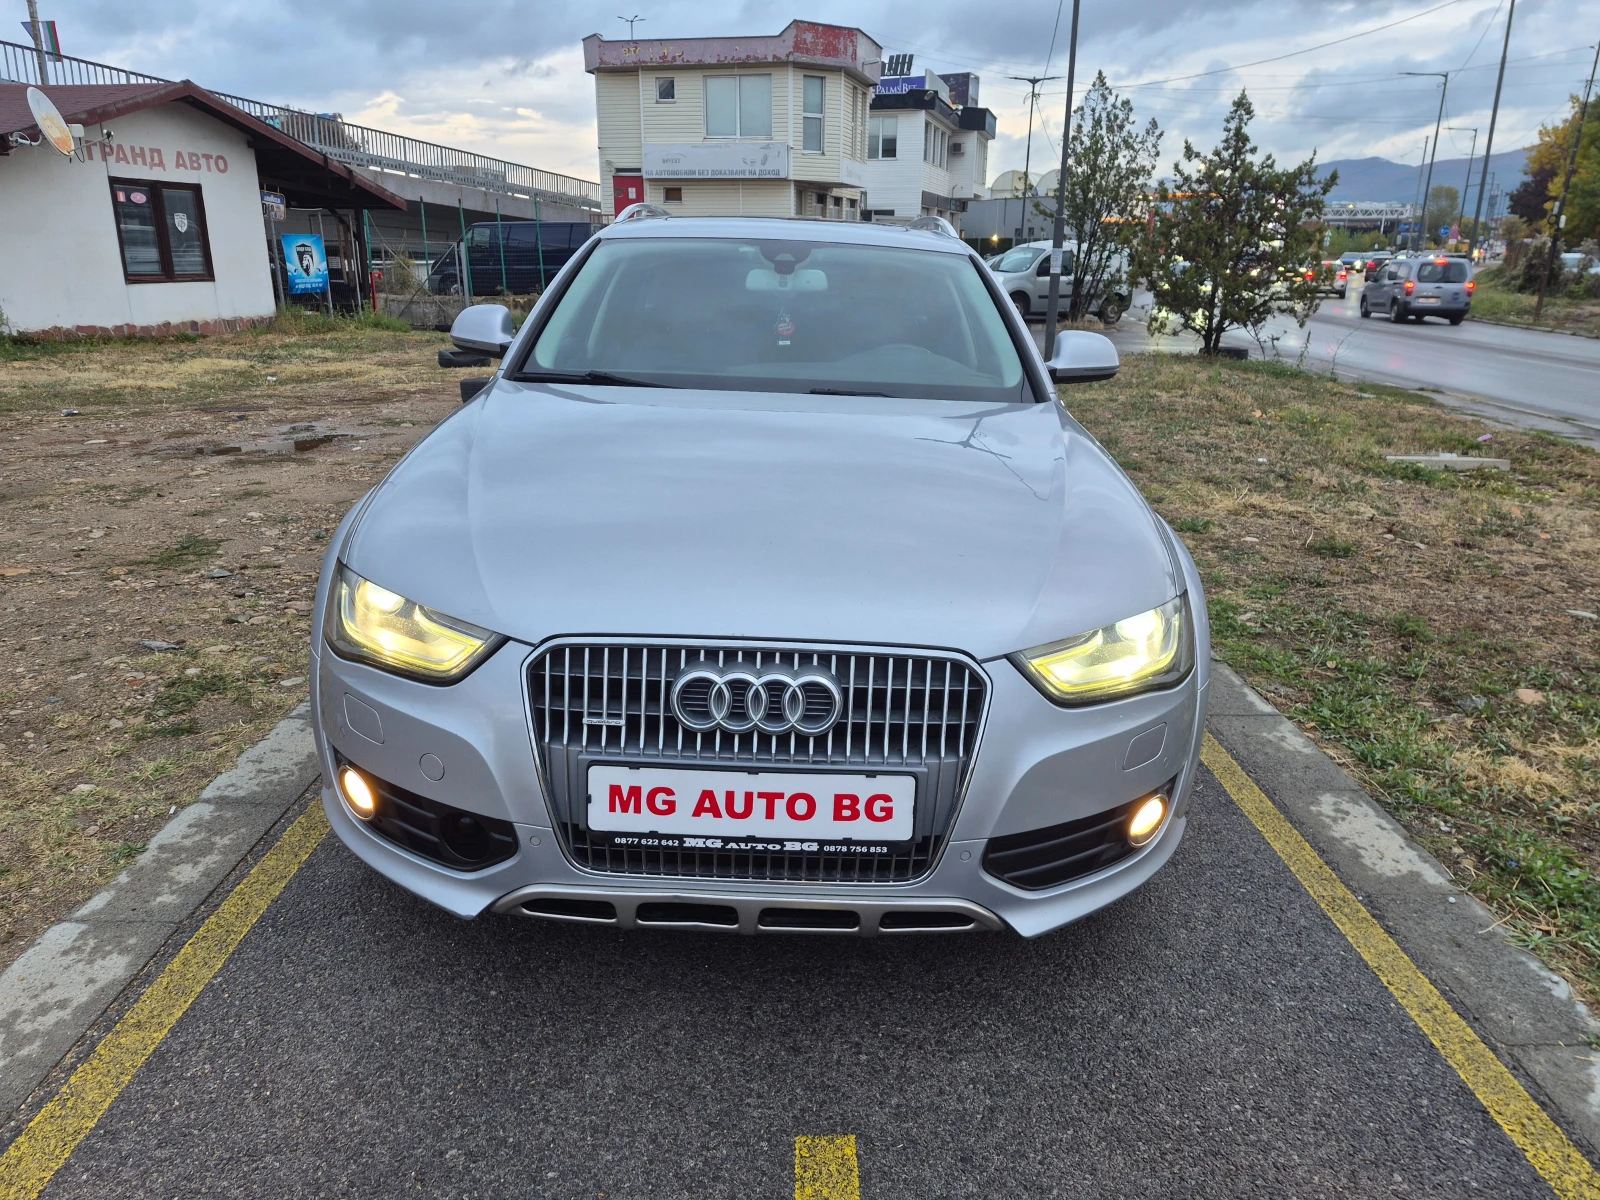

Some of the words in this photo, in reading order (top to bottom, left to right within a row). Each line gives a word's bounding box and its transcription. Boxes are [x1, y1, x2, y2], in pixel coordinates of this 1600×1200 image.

[876, 85, 901, 94] PALMS
[84, 139, 167, 172] ГРАНД
[175, 150, 229, 174] АВТО
[697, 168, 710, 176] БЕЗ
[710, 168, 747, 177] ДОКАЗВАНЕ
[748, 168, 757, 176] НА
[758, 168, 780, 177] ДОХОД
[608, 784, 677, 816] MG
[691, 789, 817, 821] AUTO
[832, 793, 894, 823] BG
[614, 837, 638, 845] 0877
[641, 838, 659, 846] 622
[683, 837, 724, 849] MG
[783, 841, 820, 852] BG
[850, 845, 867, 853] 756
